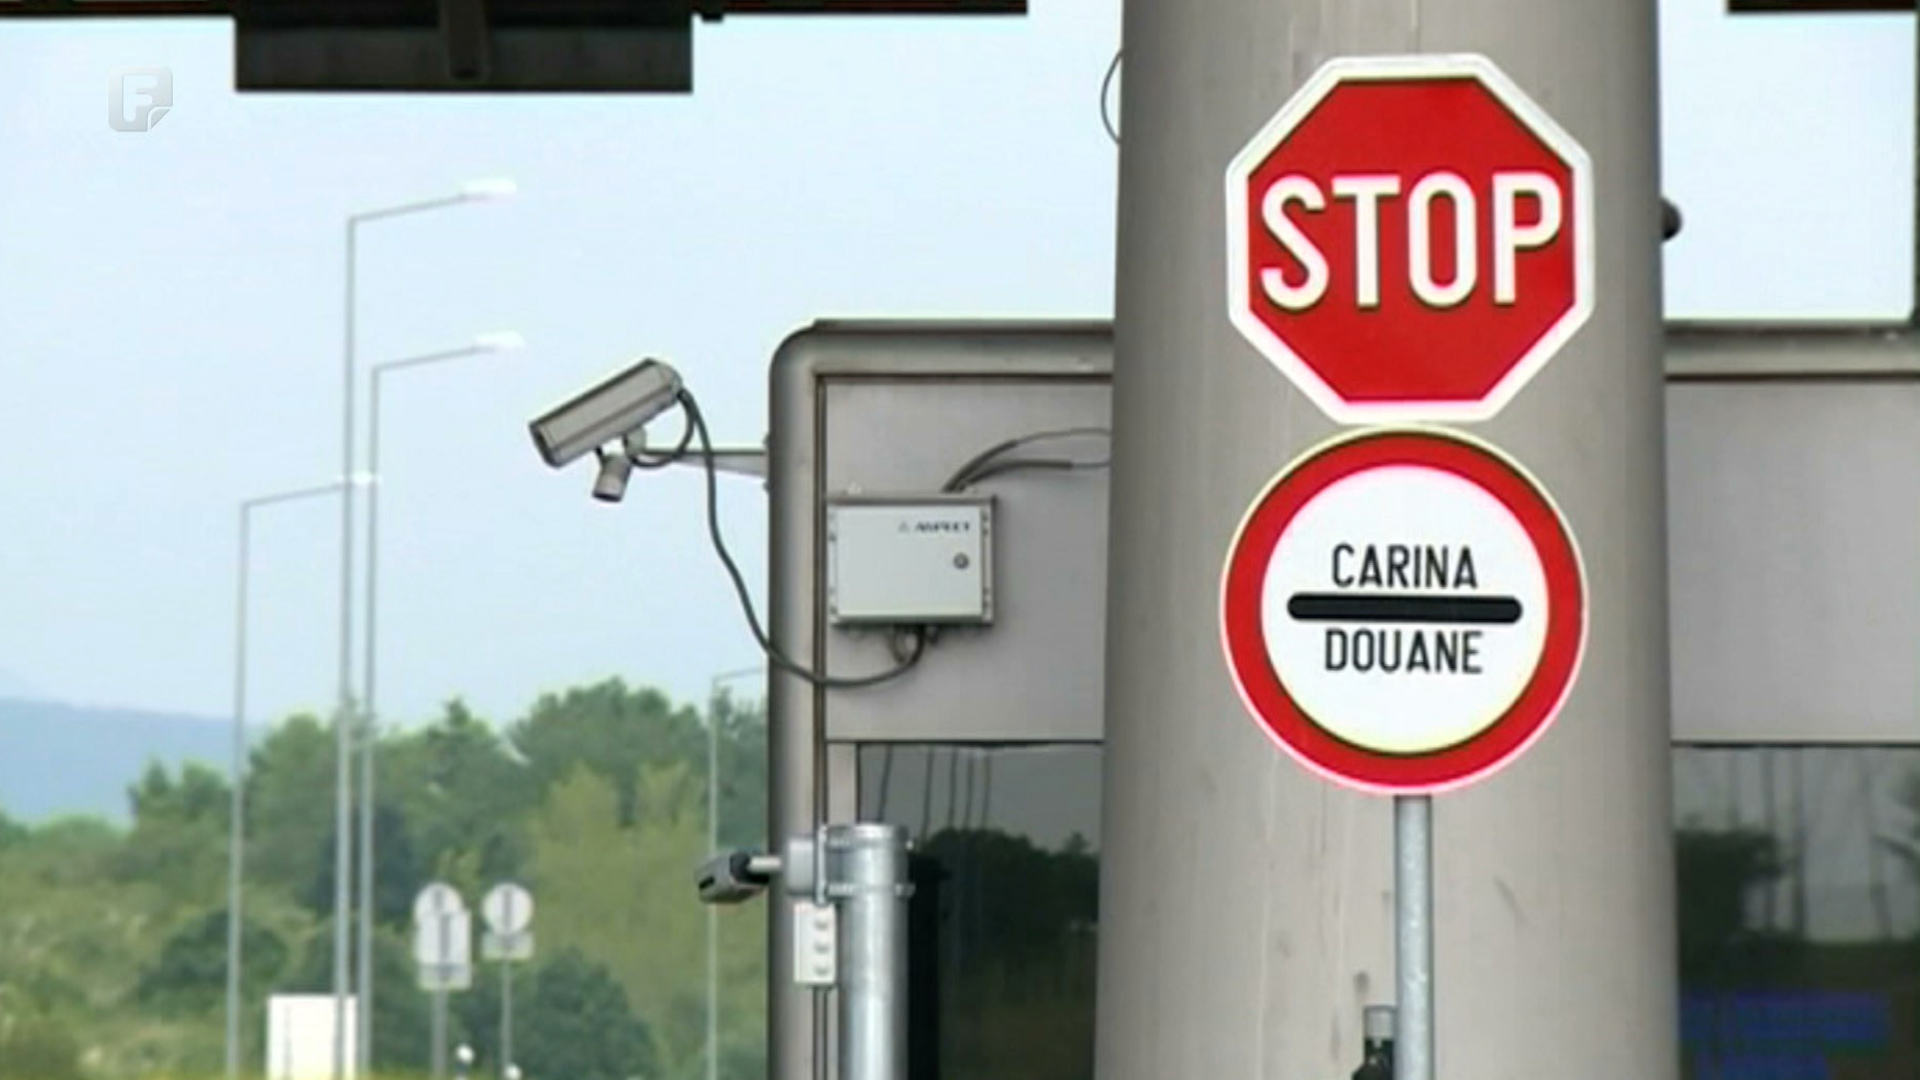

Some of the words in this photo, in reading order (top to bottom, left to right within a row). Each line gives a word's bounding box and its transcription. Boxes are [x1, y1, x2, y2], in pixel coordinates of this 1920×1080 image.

[1260, 171, 1563, 310] STOP
[1332, 543, 1478, 589] CARINA
[1325, 627, 1483, 674] DOUANE
